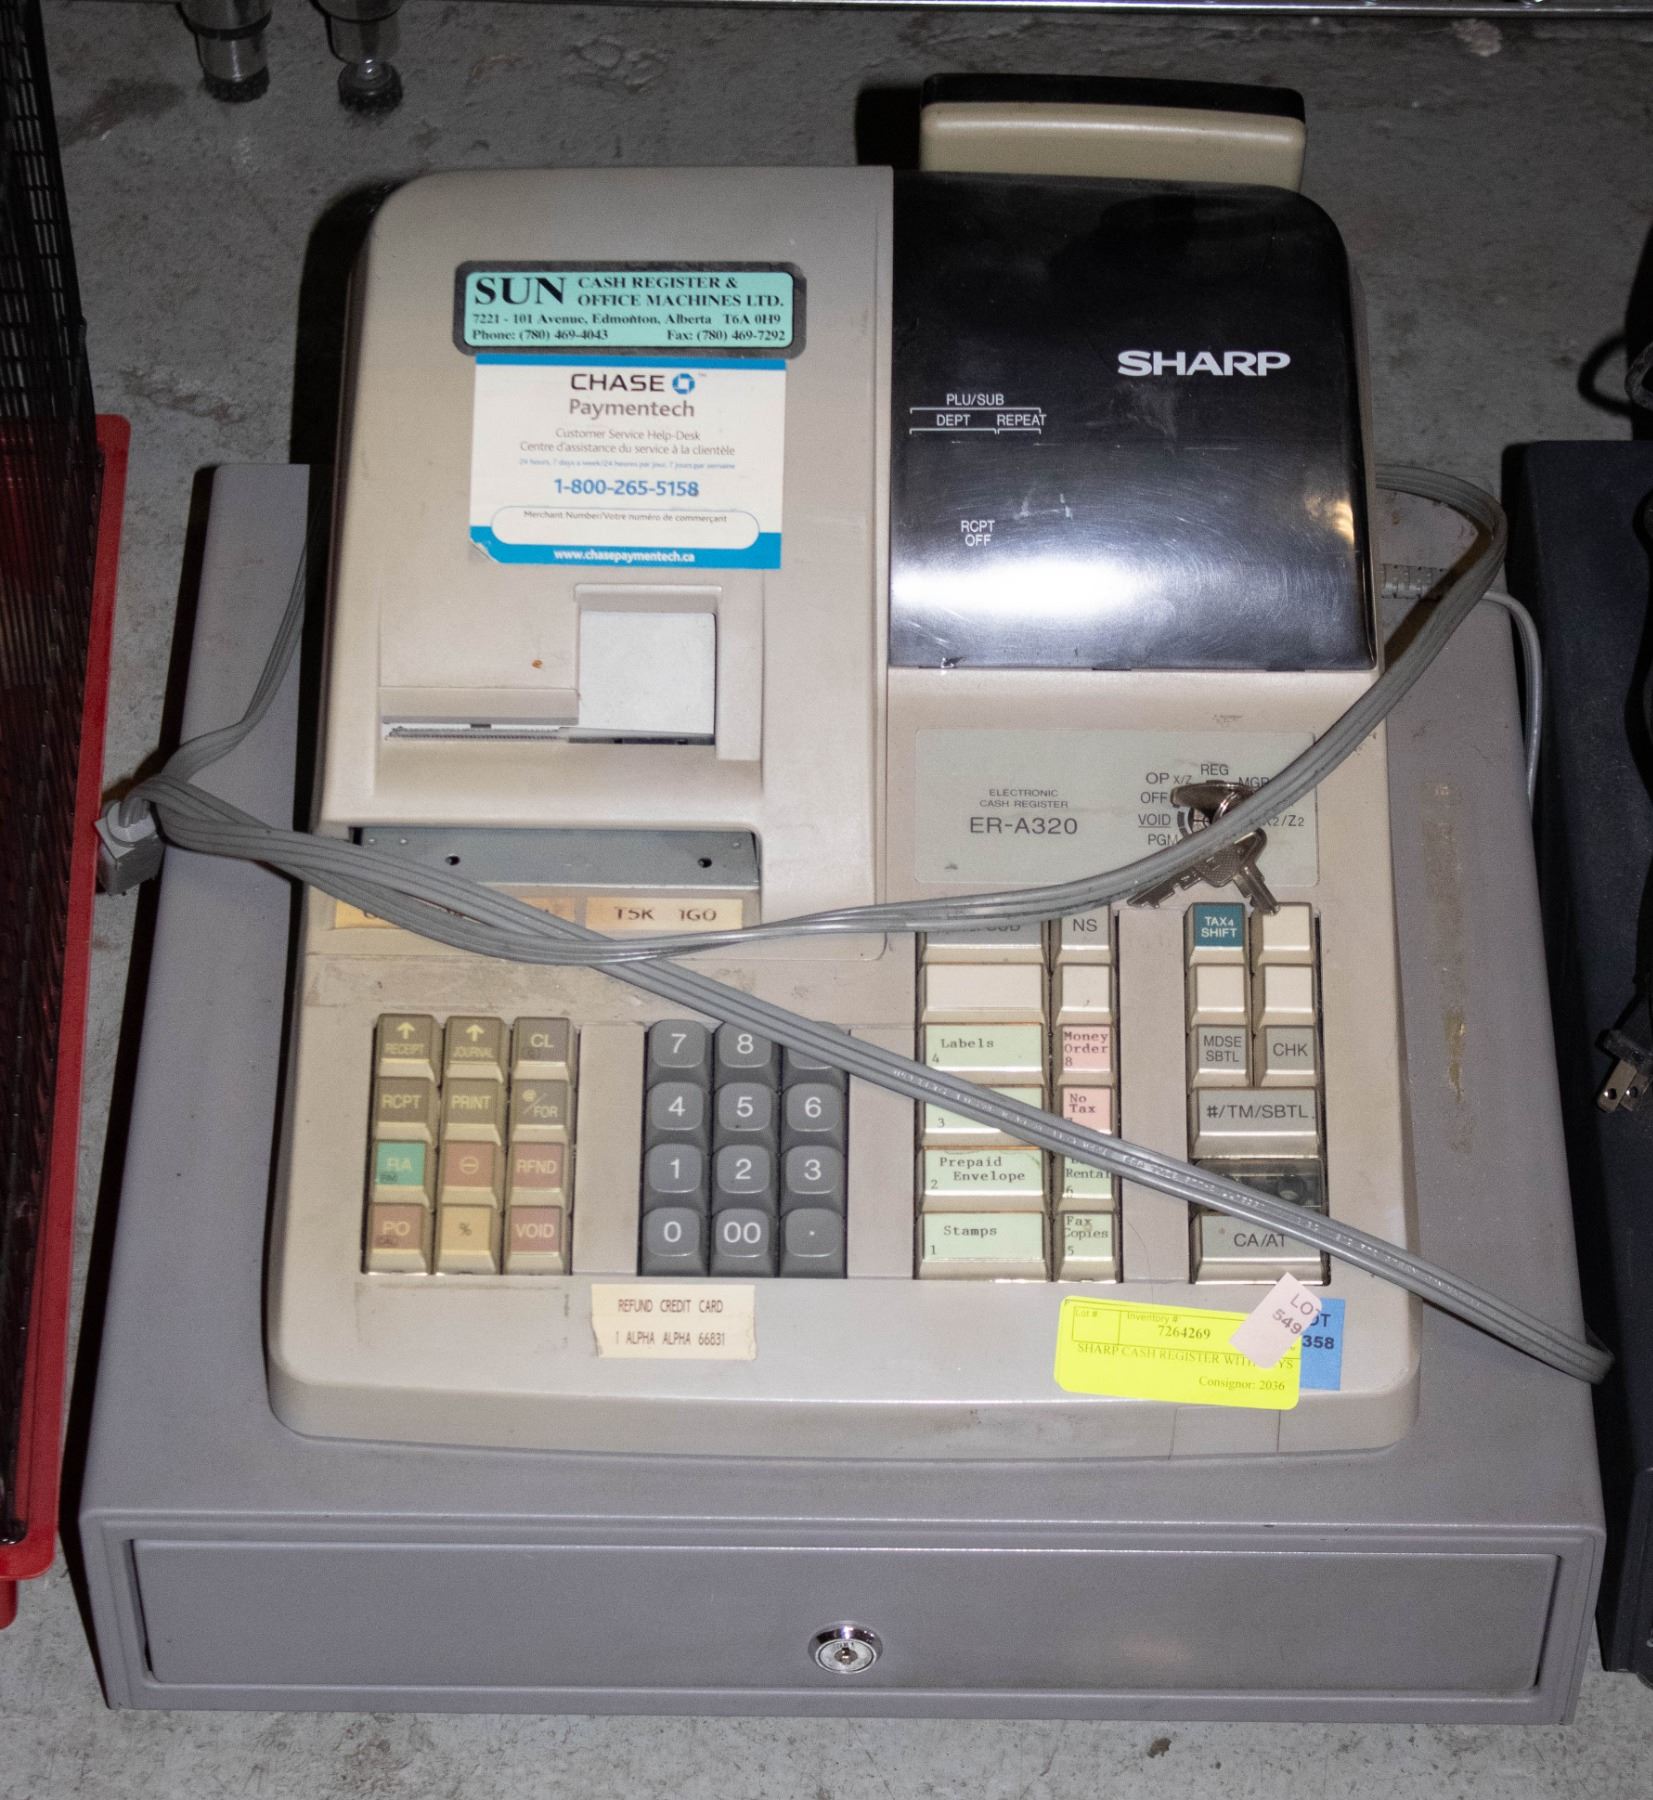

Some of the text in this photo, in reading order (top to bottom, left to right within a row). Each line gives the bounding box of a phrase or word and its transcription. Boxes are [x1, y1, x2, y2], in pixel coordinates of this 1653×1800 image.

[578, 277, 737, 288] CASH REGISTER &
[475, 277, 565, 305] SUN
[578, 294, 784, 307] OFFICE MACHINES LTD.
[473, 314, 499, 324] 7221
[514, 314, 532, 324] 101
[538, 314, 587, 325] Avenue,
[592, 314, 661, 325] Edmonton,
[665, 314, 711, 324] Alberta
[723, 314, 750, 324] T6A
[472, 329, 609, 341] Phone: (780) 469-4043
[667, 329, 785, 341] Fax: (780) 469-7292
[1117, 350, 1291, 376] SHARP
[571, 373, 665, 392] CHASE
[946, 393, 1004, 407] PLU/SUB
[569, 398, 695, 420] Paymentech
[936, 414, 970, 426] DEPT
[997, 414, 1047, 426] REPEAT
[555, 427, 701, 442] Customer Service Help-Desk
[520, 441, 735, 456] Centre d'assistance du service à la clientèle
[554, 478, 699, 497] 1-800-265-5158
[523, 510, 563, 519] Merchant
[628, 513, 660, 521] numéro
[961, 520, 995, 532] RCPT
[965, 534, 991, 546] OFF
[553, 548, 696, 564] www.chasepaymentech.ca
[1201, 763, 1229, 776] REG
[1146, 773, 1192, 785] OP X/Z
[988, 788, 1058, 798] ELECTRONIC
[1140, 791, 1168, 804] OFF
[980, 800, 1069, 809] CASH REGISTER
[970, 817, 1078, 835] ER-A320
[1138, 814, 1171, 826] VOID
[1148, 834, 1178, 846] PGM
[1072, 919, 1098, 932] NS
[1205, 916, 1234, 927] TAX4
[1201, 927, 1237, 938] SHIFT
[530, 1033, 554, 1049] CL
[671, 1033, 687, 1053] 7
[736, 1033, 754, 1054] 8
[940, 1038, 994, 1049] Labels
[1063, 1031, 1109, 1043] Money
[1204, 1036, 1242, 1048] MDSE
[1064, 1043, 1109, 1054] Order
[1273, 1043, 1308, 1057] CHK
[932, 1053, 940, 1064] 4
[1064, 1056, 1073, 1067] 8
[1206, 1051, 1240, 1063] SBTL
[381, 1094, 422, 1109] RCPT
[451, 1095, 491, 1109] PRINT
[1069, 1093, 1087, 1103] No
[668, 1096, 686, 1116] 4
[736, 1096, 753, 1117] 5
[804, 1096, 822, 1118] 6
[1069, 1103, 1096, 1114] Tax
[936, 1117, 945, 1128] 3
[516, 1159, 557, 1175] RFND
[670, 1158, 680, 1179] 1
[735, 1158, 752, 1180] 2
[940, 1156, 1002, 1169] Prepaid
[804, 1159, 822, 1180] 3
[953, 1171, 1025, 1183] Envelope
[930, 1179, 938, 1190] 2
[1066, 1215, 1092, 1227] Fax
[382, 1221, 411, 1236] PO
[459, 1221, 472, 1236] %
[516, 1223, 554, 1238] VOID
[663, 1221, 682, 1242] 0
[723, 1221, 761, 1243] 00
[943, 1225, 997, 1237] Stamps
[1233, 1232, 1287, 1248] CA/AT
[929, 1244, 937, 1256] 1
[1067, 1245, 1075, 1256] 5
[618, 1299, 724, 1313] REFUND CREDIT CARD
[1272, 1308, 1303, 1335] 549
[626, 1331, 655, 1345] ALPHA
[662, 1332, 691, 1345] ALPHA
[698, 1332, 725, 1346] 66831
[1158, 1325, 1211, 1339] 7264269
[1302, 1335, 1335, 1349] 358
[1077, 1343, 1119, 1356] SHARP
[1121, 1346, 1156, 1359] CASH
[1159, 1349, 1220, 1365] REGISTER
[1199, 1376, 1286, 1391] Consignor: 2036
